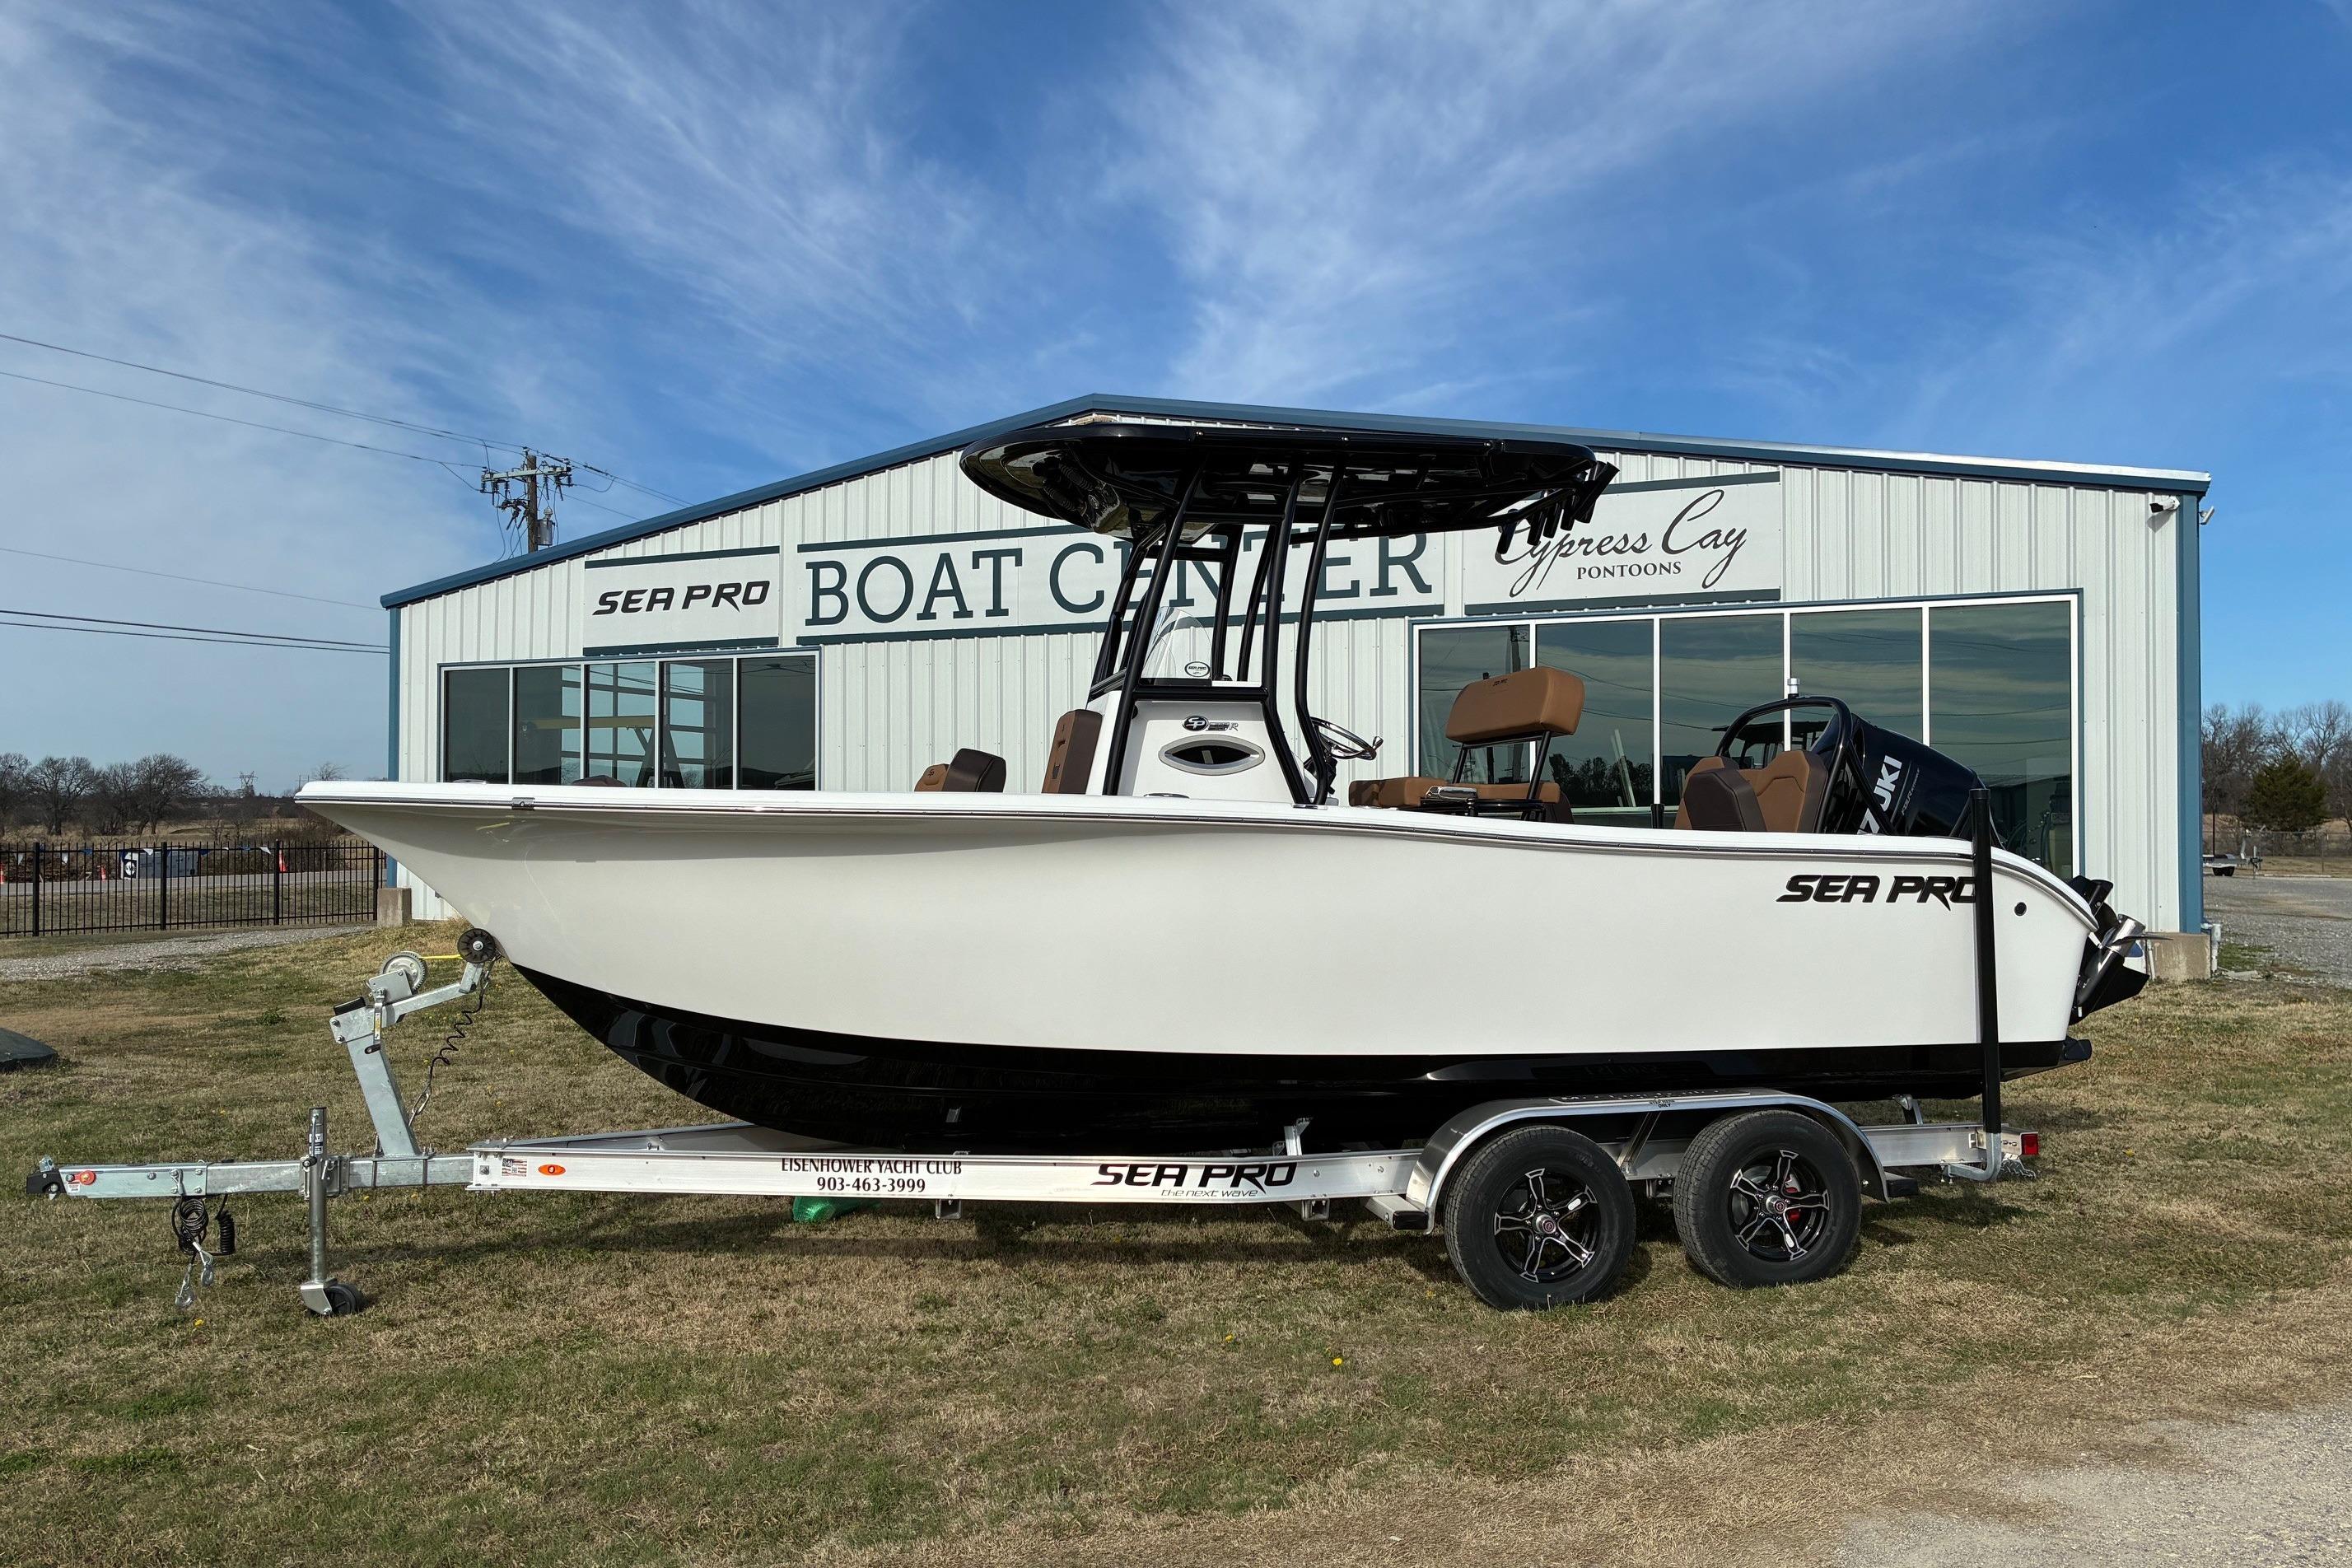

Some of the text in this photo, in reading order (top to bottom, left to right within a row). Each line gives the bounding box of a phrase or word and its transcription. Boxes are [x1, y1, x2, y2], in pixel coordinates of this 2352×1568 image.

[1662, 488, 1748, 589] Cay
[805, 548, 1023, 626] BOAT
[1577, 561, 1682, 580] PONTOONS
[592, 580, 770, 616] SEA PRO
[1856, 755, 1902, 834] ZUKI
[1776, 875, 1976, 912] SEA PRO
[782, 1158, 962, 1175] EISENHOWER YACHT CLUB
[1090, 1162, 1297, 1194] SEA PRO
[817, 1177, 926, 1193] 903-463-3999
[1186, 1189, 1219, 1197] next
[1221, 1189, 1258, 1197] wave
